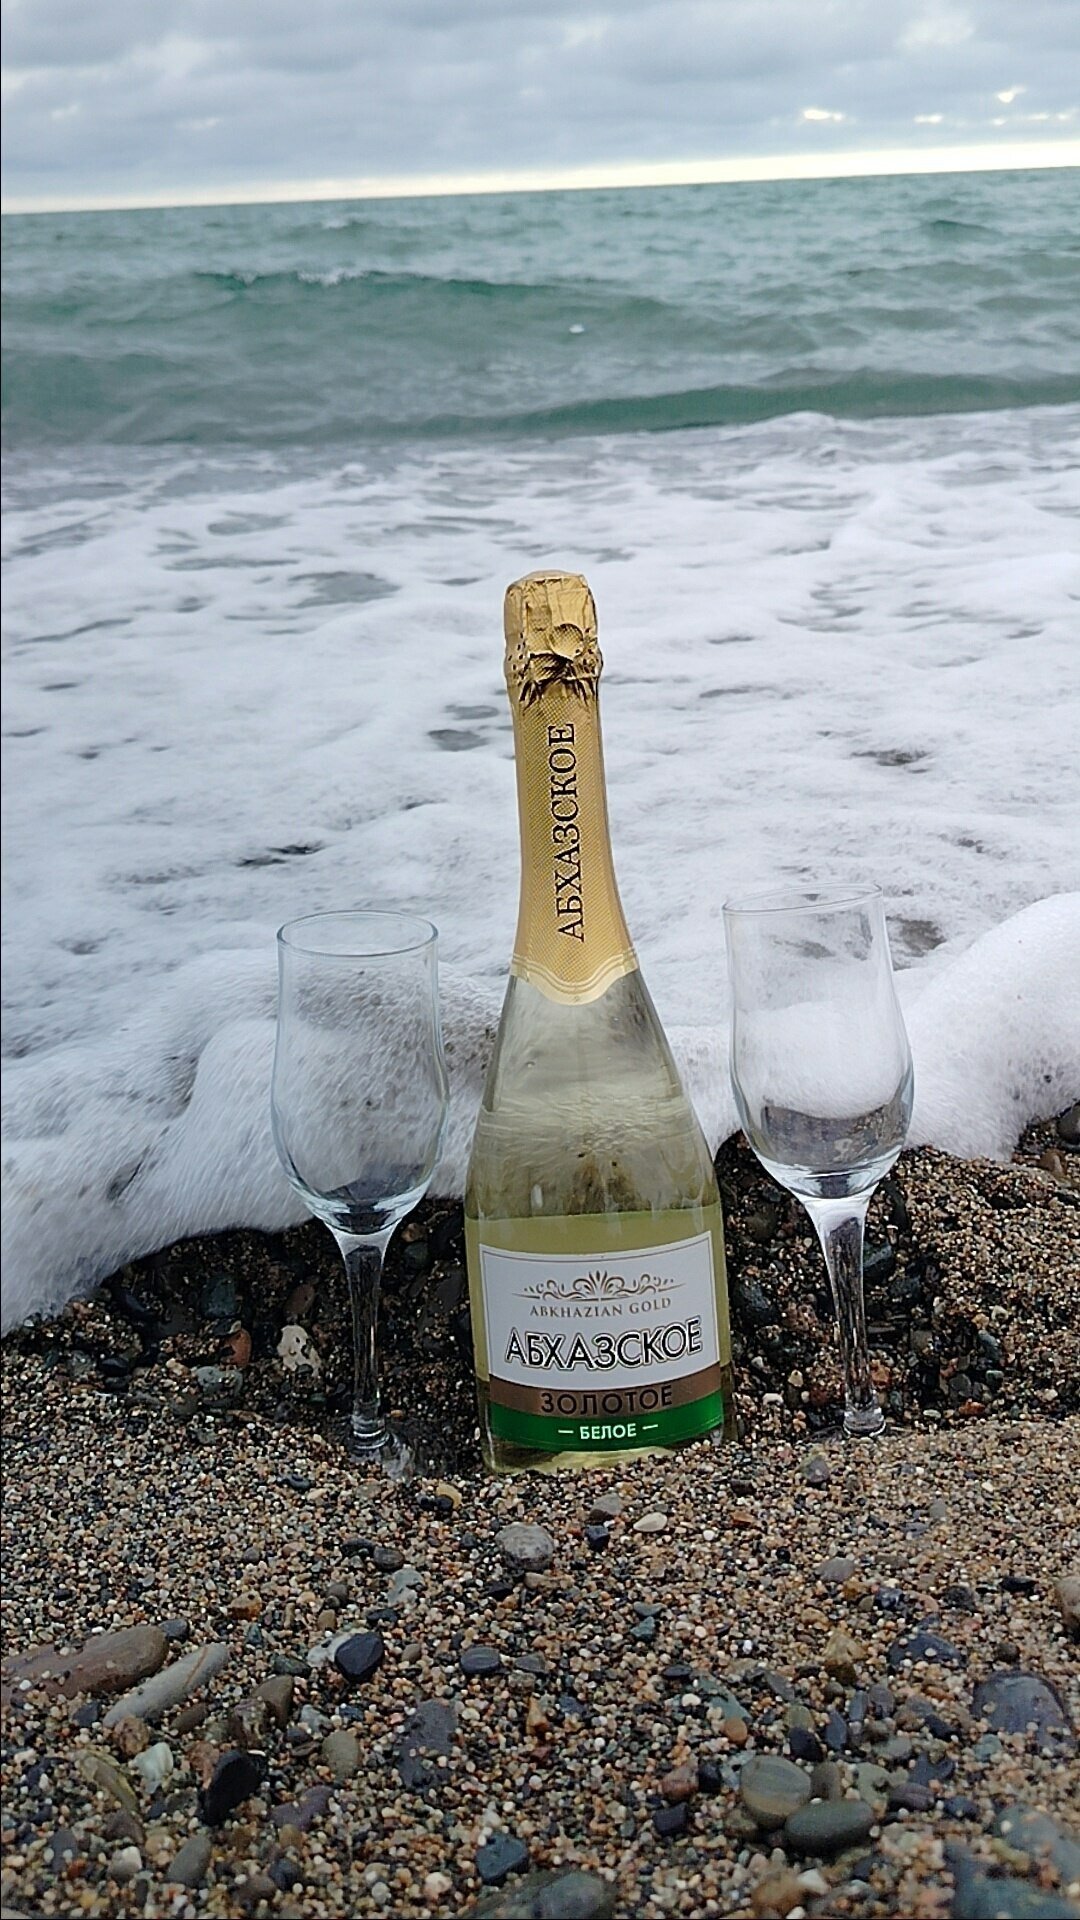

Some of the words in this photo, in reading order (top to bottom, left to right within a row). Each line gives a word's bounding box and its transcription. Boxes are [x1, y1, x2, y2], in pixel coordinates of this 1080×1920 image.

[547, 722, 585, 942] АБХАЗСКОЕ
[530, 1304, 623, 1318] ABKHAZIAN
[629, 1297, 672, 1315] GOLD
[505, 1316, 702, 1370] АБХАЗСКОЕ
[541, 1385, 673, 1415] ЗОЛОТОЕ
[580, 1423, 637, 1440] БЕЛОЕ
